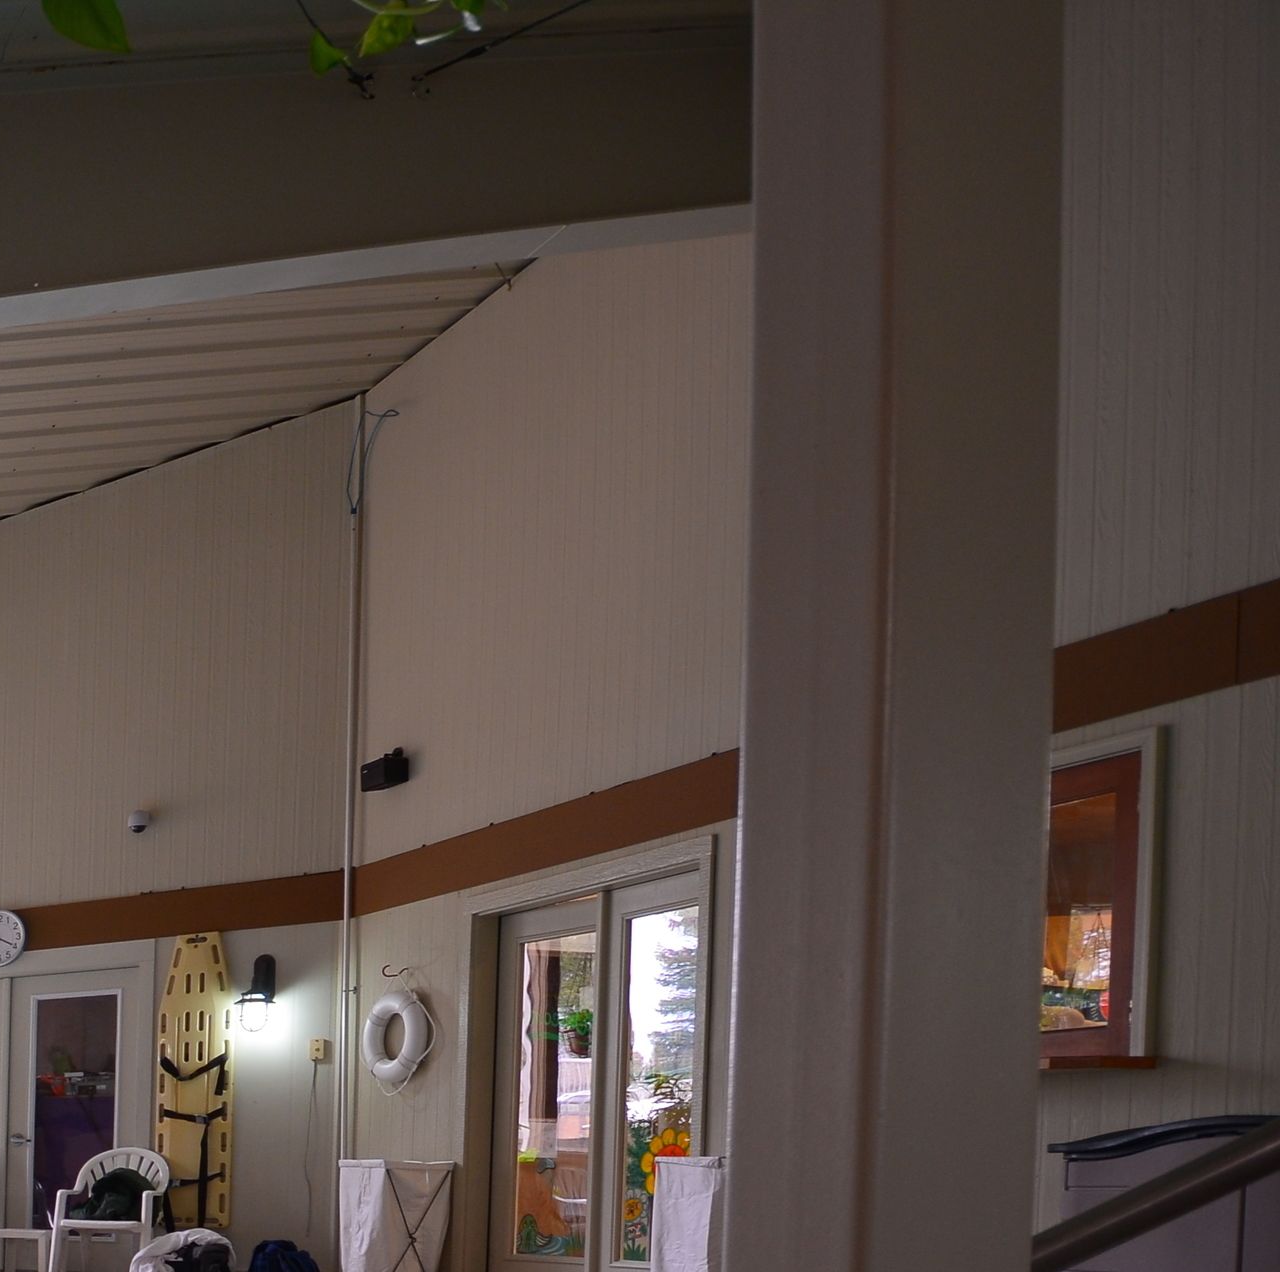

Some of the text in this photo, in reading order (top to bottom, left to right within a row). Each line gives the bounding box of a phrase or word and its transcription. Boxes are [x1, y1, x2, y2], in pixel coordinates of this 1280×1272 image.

[13, 922, 19, 930] 2
[16, 932, 22, 941] 3
[5, 951, 11, 959] 5
